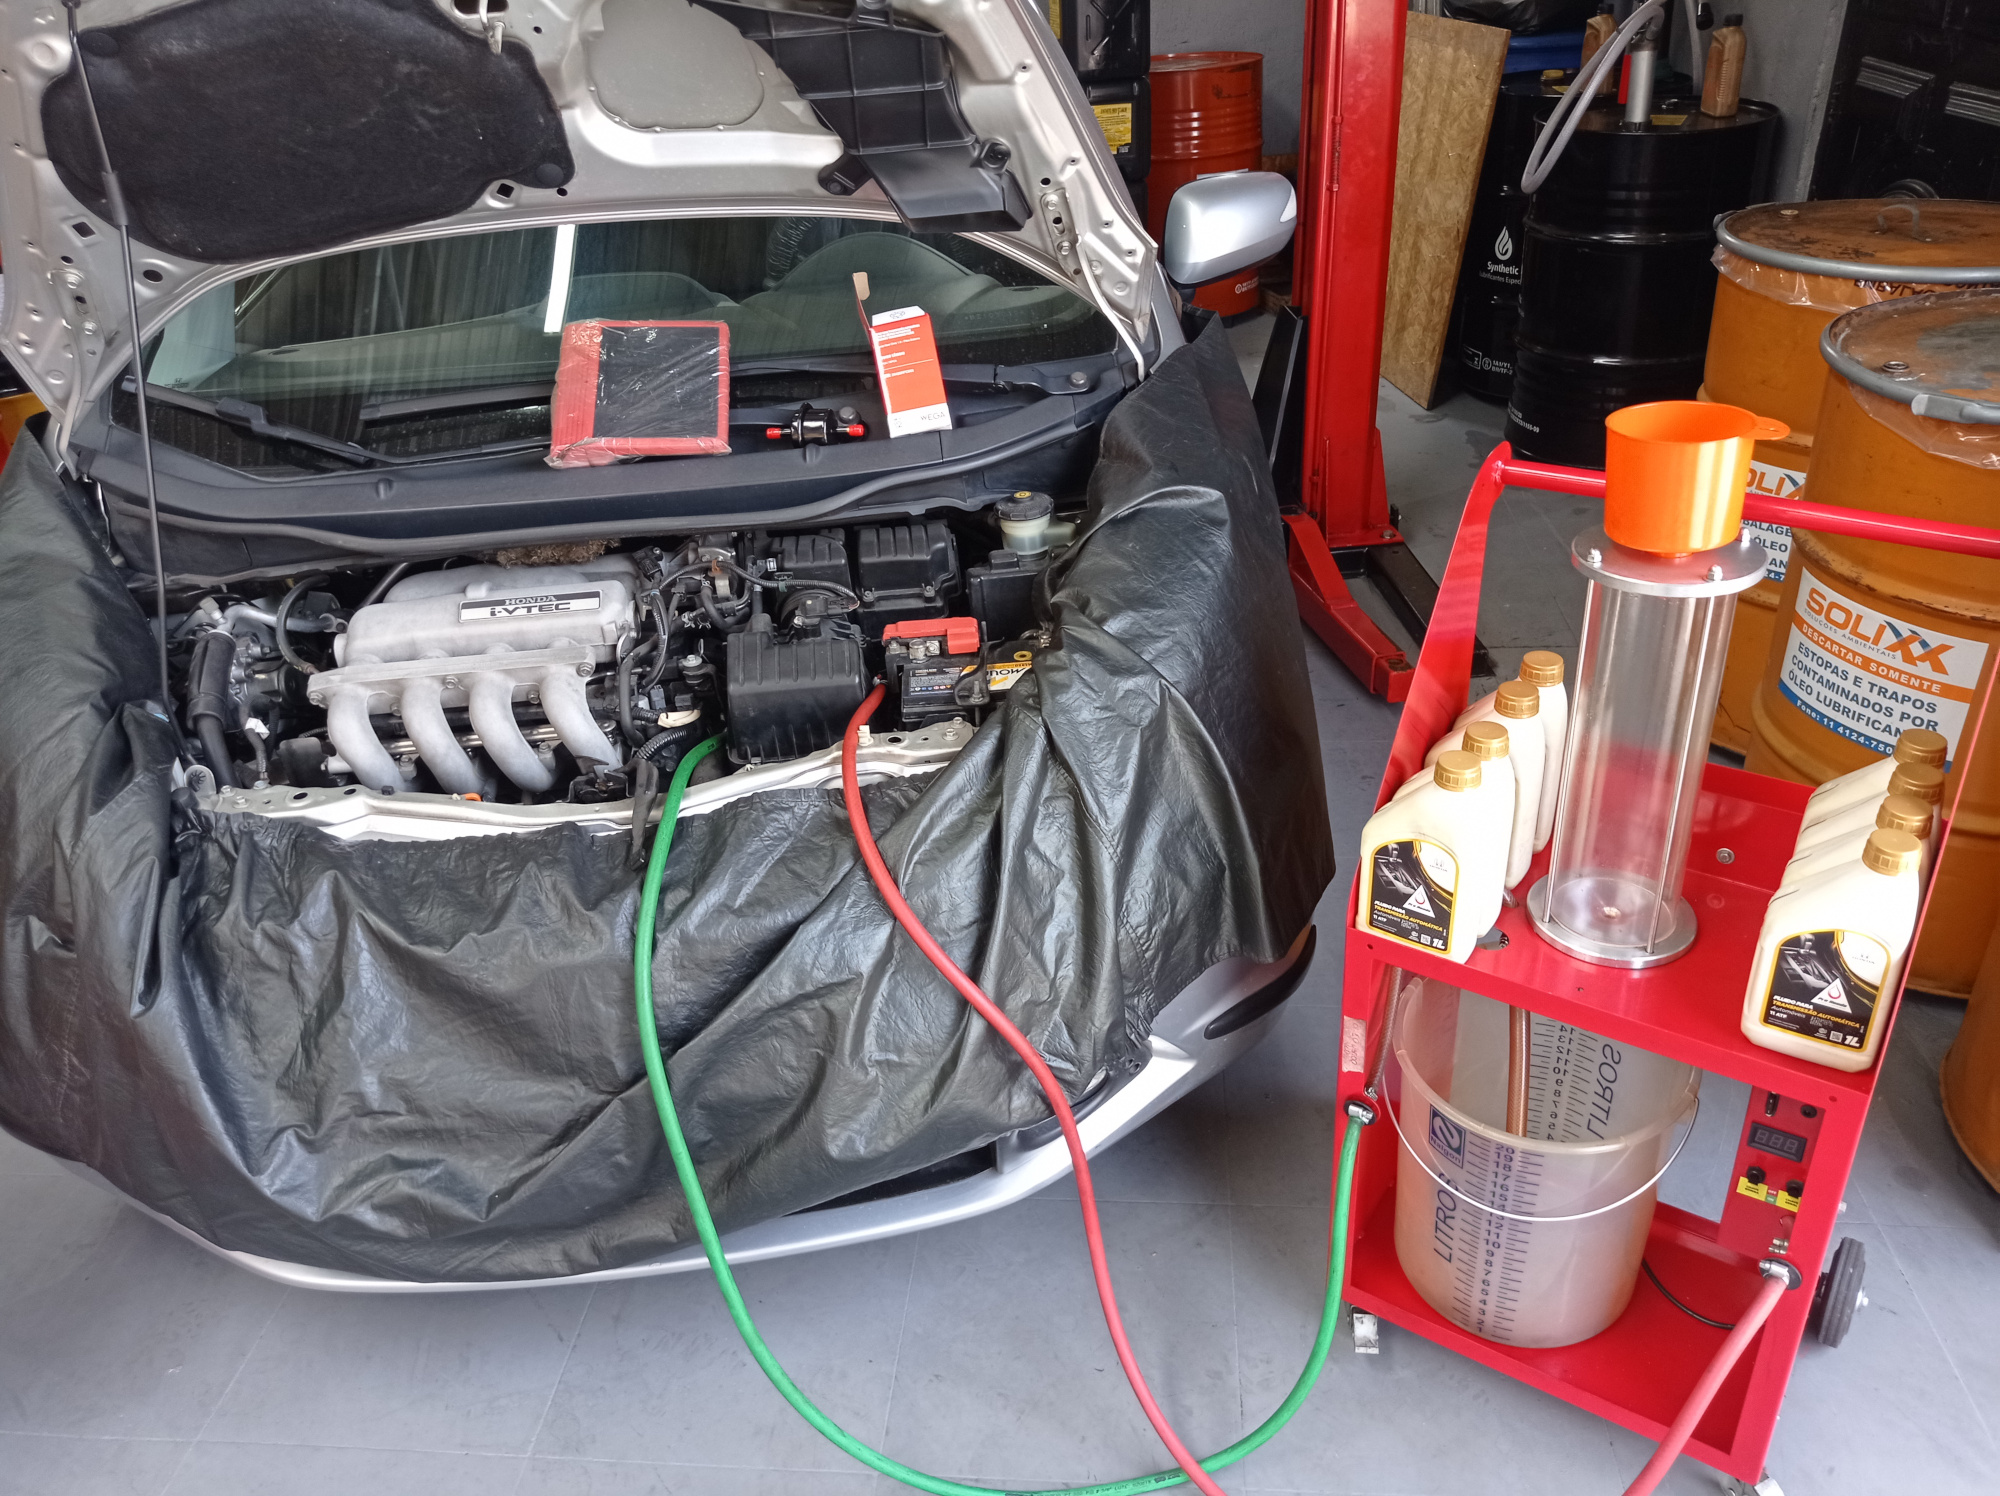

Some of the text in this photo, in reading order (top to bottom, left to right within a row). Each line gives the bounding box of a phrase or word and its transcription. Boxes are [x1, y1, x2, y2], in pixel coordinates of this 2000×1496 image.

[1487, 261, 1519, 275] Synthetic
[920, 411, 946, 421] WEGA
[504, 595, 557, 606] HONDA
[1804, 607, 1897, 660] SOLUÇÕES AMBIENTAIS
[1805, 587, 1955, 676] SOLIXX
[1802, 623, 1942, 694] DESCARTAR SOMENTE
[1788, 668, 1813, 697] ÓLEO
[1797, 641, 1938, 714] ESTOPAS E TRAPOS
[1791, 654, 1939, 732] CONTAMINADOS POR
[1796, 700, 1821, 722] Fone:
[1823, 716, 1834, 729] 11
[1373, 910, 1401, 922] Automóveis
[1373, 905, 1409, 920] TRANSMISSÃO
[1408, 916, 1443, 932] AUTOMÁTICA
[1432, 937, 1445, 950] 1L
[1772, 995, 1814, 1010] FLUIDO PARA
[1770, 1005, 1806, 1018] Automóveis
[1772, 1000, 1817, 1016] TRANSMISSÃO
[1817, 1012, 1860, 1029] AUTOMÁTICA
[1844, 1035, 1861, 1048] 1L
[1430, 1135, 1461, 1164] Nalgon
[1495, 1143, 1515, 1155] 20
[1494, 1152, 1513, 1163] 19
[1493, 1161, 1512, 1172] 18
[1492, 1171, 1511, 1182] 17
[1491, 1181, 1509, 1192] 16
[1490, 1191, 1508, 1202] 15
[1485, 1219, 1504, 1231] 12
[1485, 1229, 1500, 1240] 11
[1483, 1239, 1501, 1249] 10
[1485, 1249, 1495, 1258] 9
[1484, 1259, 1493, 1267] 8
[1483, 1268, 1492, 1276] 7
[1481, 1279, 1490, 1287] 6
[1480, 1288, 1489, 1296] 5
[1478, 1307, 1486, 1316] 3
[1476, 1318, 1485, 1327] 2
